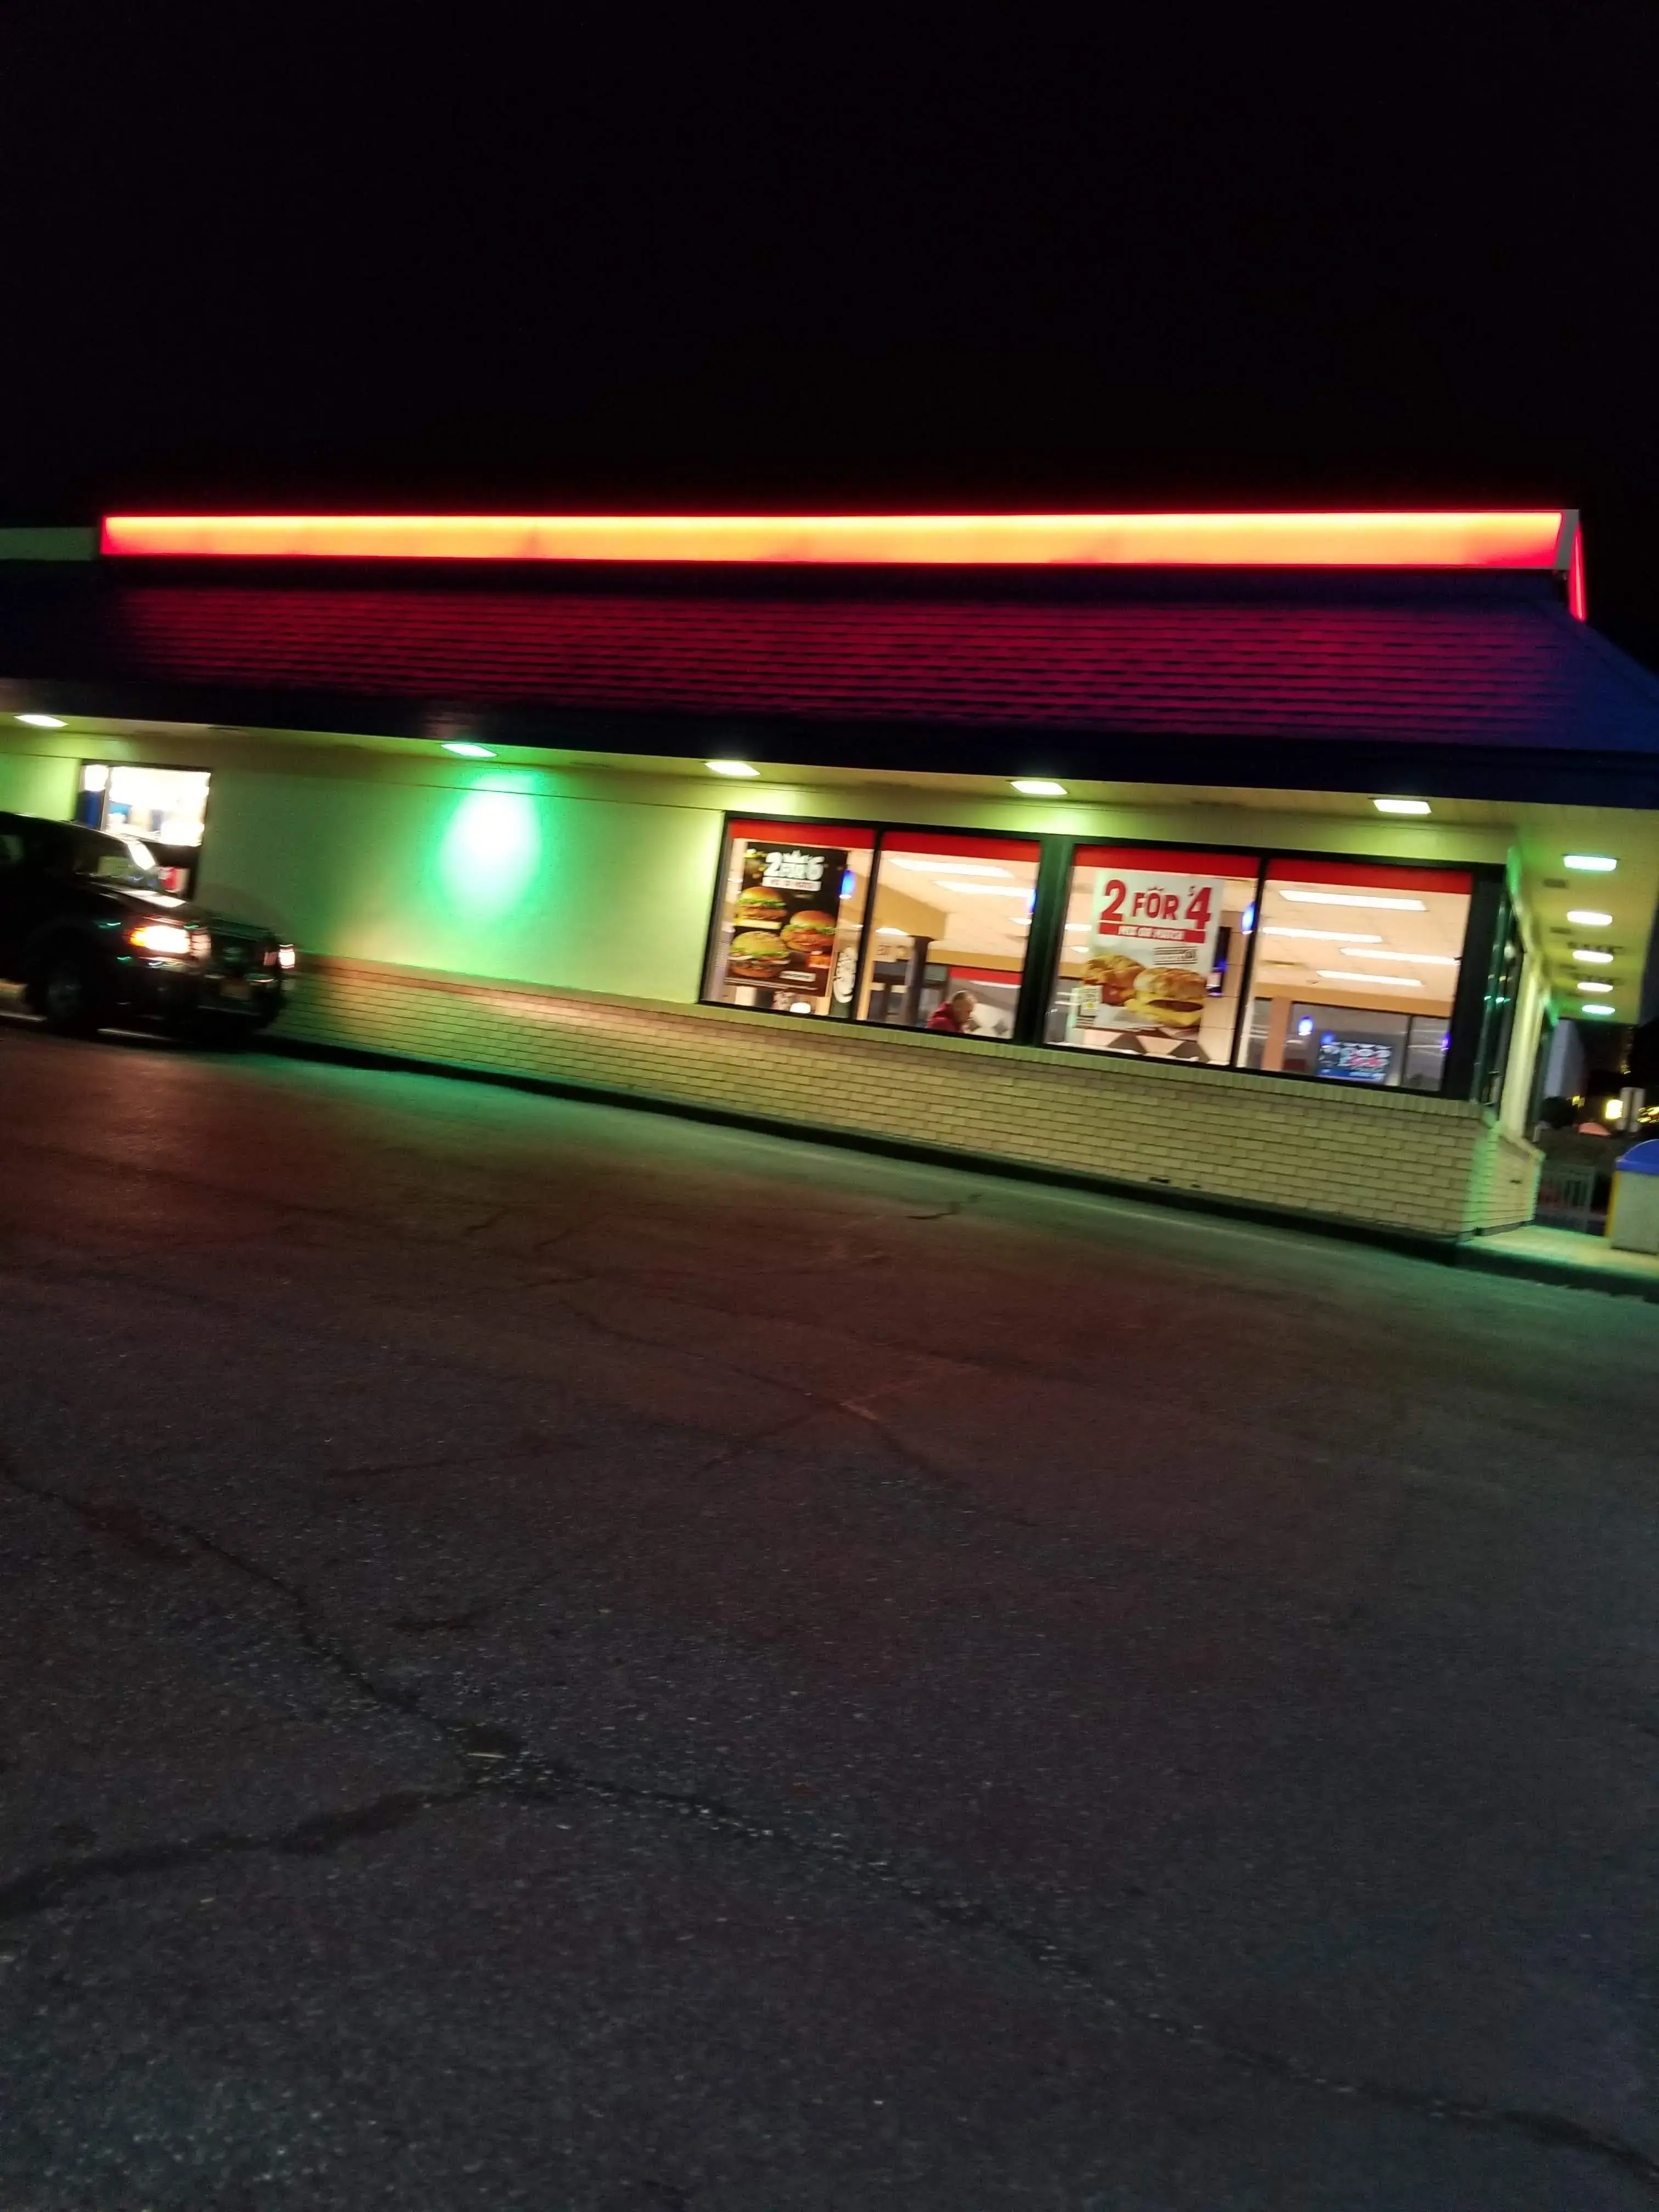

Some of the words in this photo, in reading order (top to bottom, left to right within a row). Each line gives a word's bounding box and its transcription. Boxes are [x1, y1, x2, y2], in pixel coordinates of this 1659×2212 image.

[764, 851, 782, 877] 2
[1101, 879, 1126, 922] 2
[1132, 892, 1179, 920] FOR
